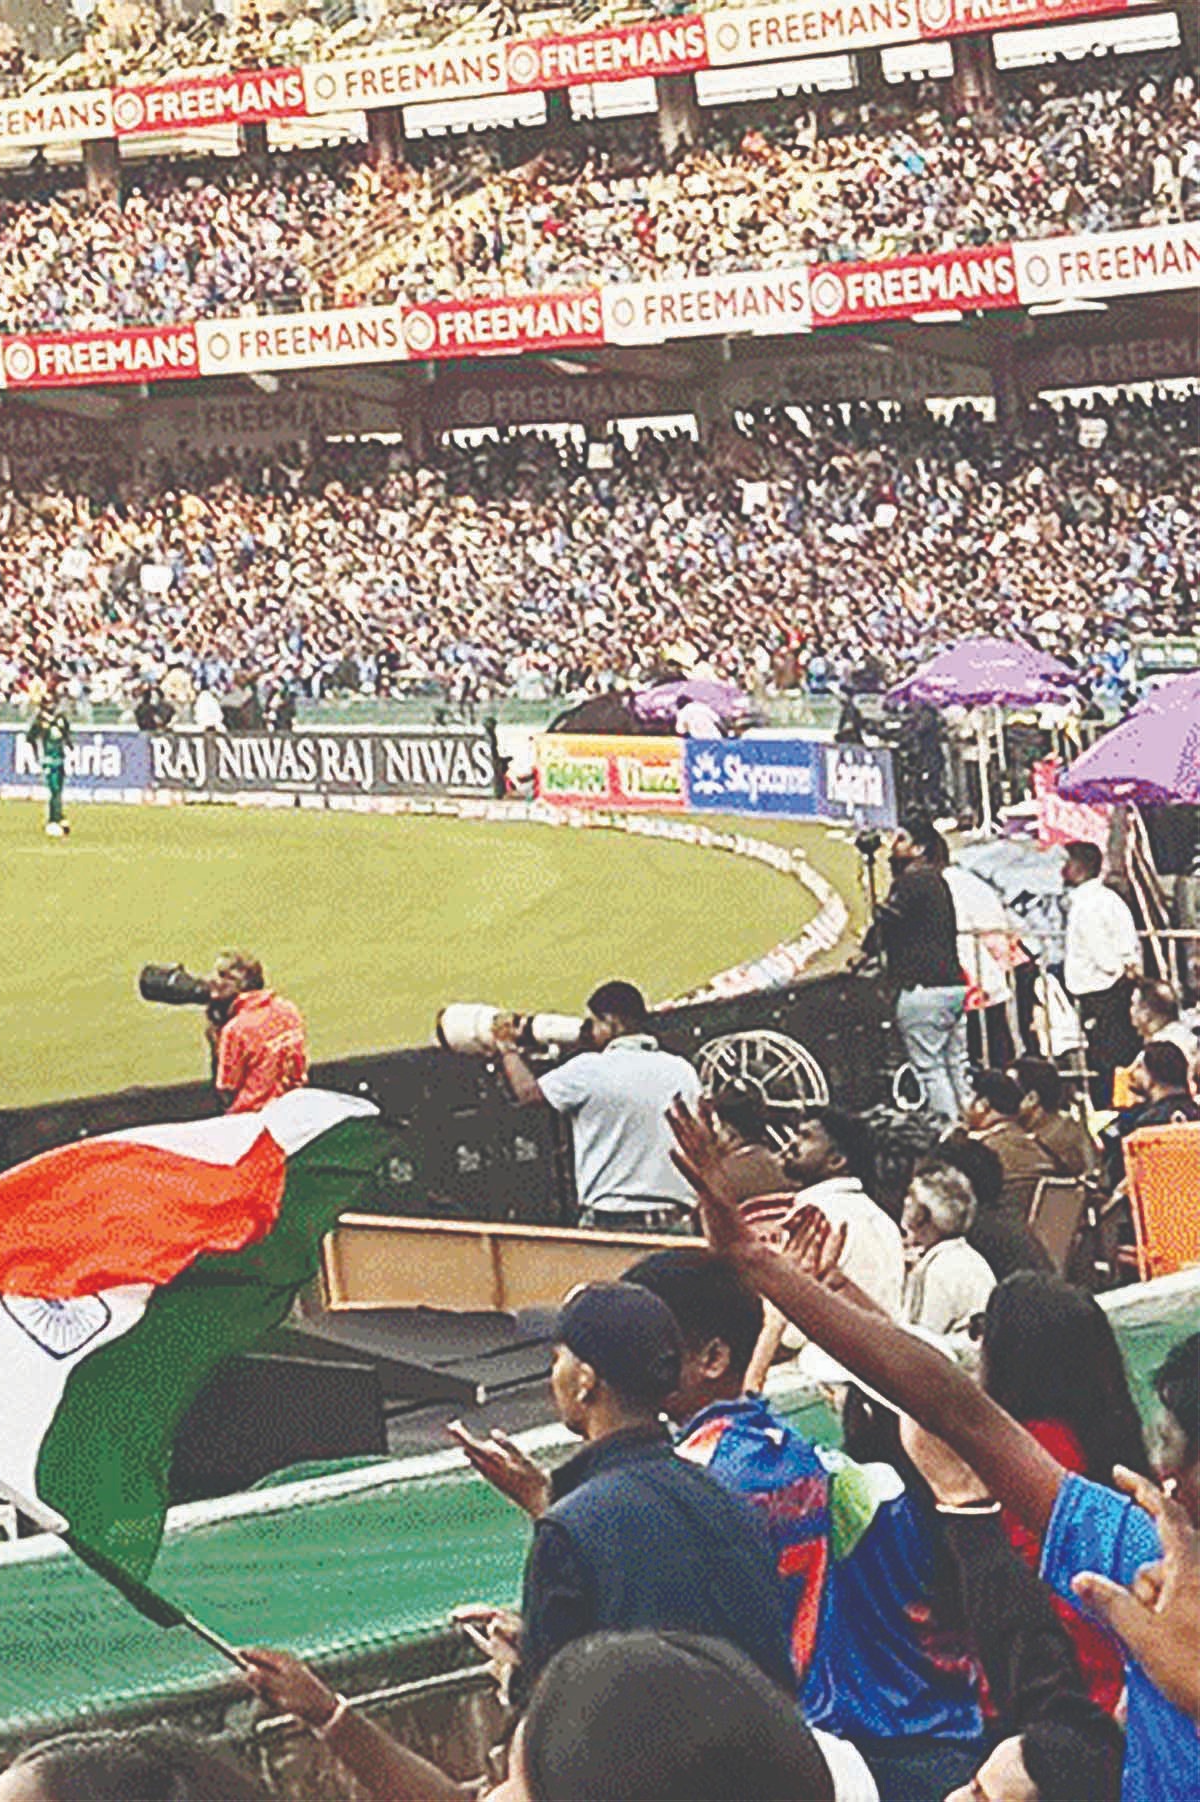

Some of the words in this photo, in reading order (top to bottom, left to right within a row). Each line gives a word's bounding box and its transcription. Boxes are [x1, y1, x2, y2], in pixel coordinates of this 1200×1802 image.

[542, 23, 704, 78] FREEMANS
[749, 3, 911, 50] FREEMANS
[145, 74, 303, 123] FREEMANS
[346, 54, 501, 99] FREEMANS
[644, 281, 808, 326] FREEMANS
[847, 255, 1015, 310] FREEMANS
[239, 318, 399, 359] FREEMANS
[438, 298, 601, 346] FREEMANS
[37, 333, 198, 376] FREEMANS
[152, 736, 207, 787] RAJ
[215, 735, 318, 781] NIWAS
[319, 736, 374, 791] RAJ
[383, 736, 495, 786] NIWAS
